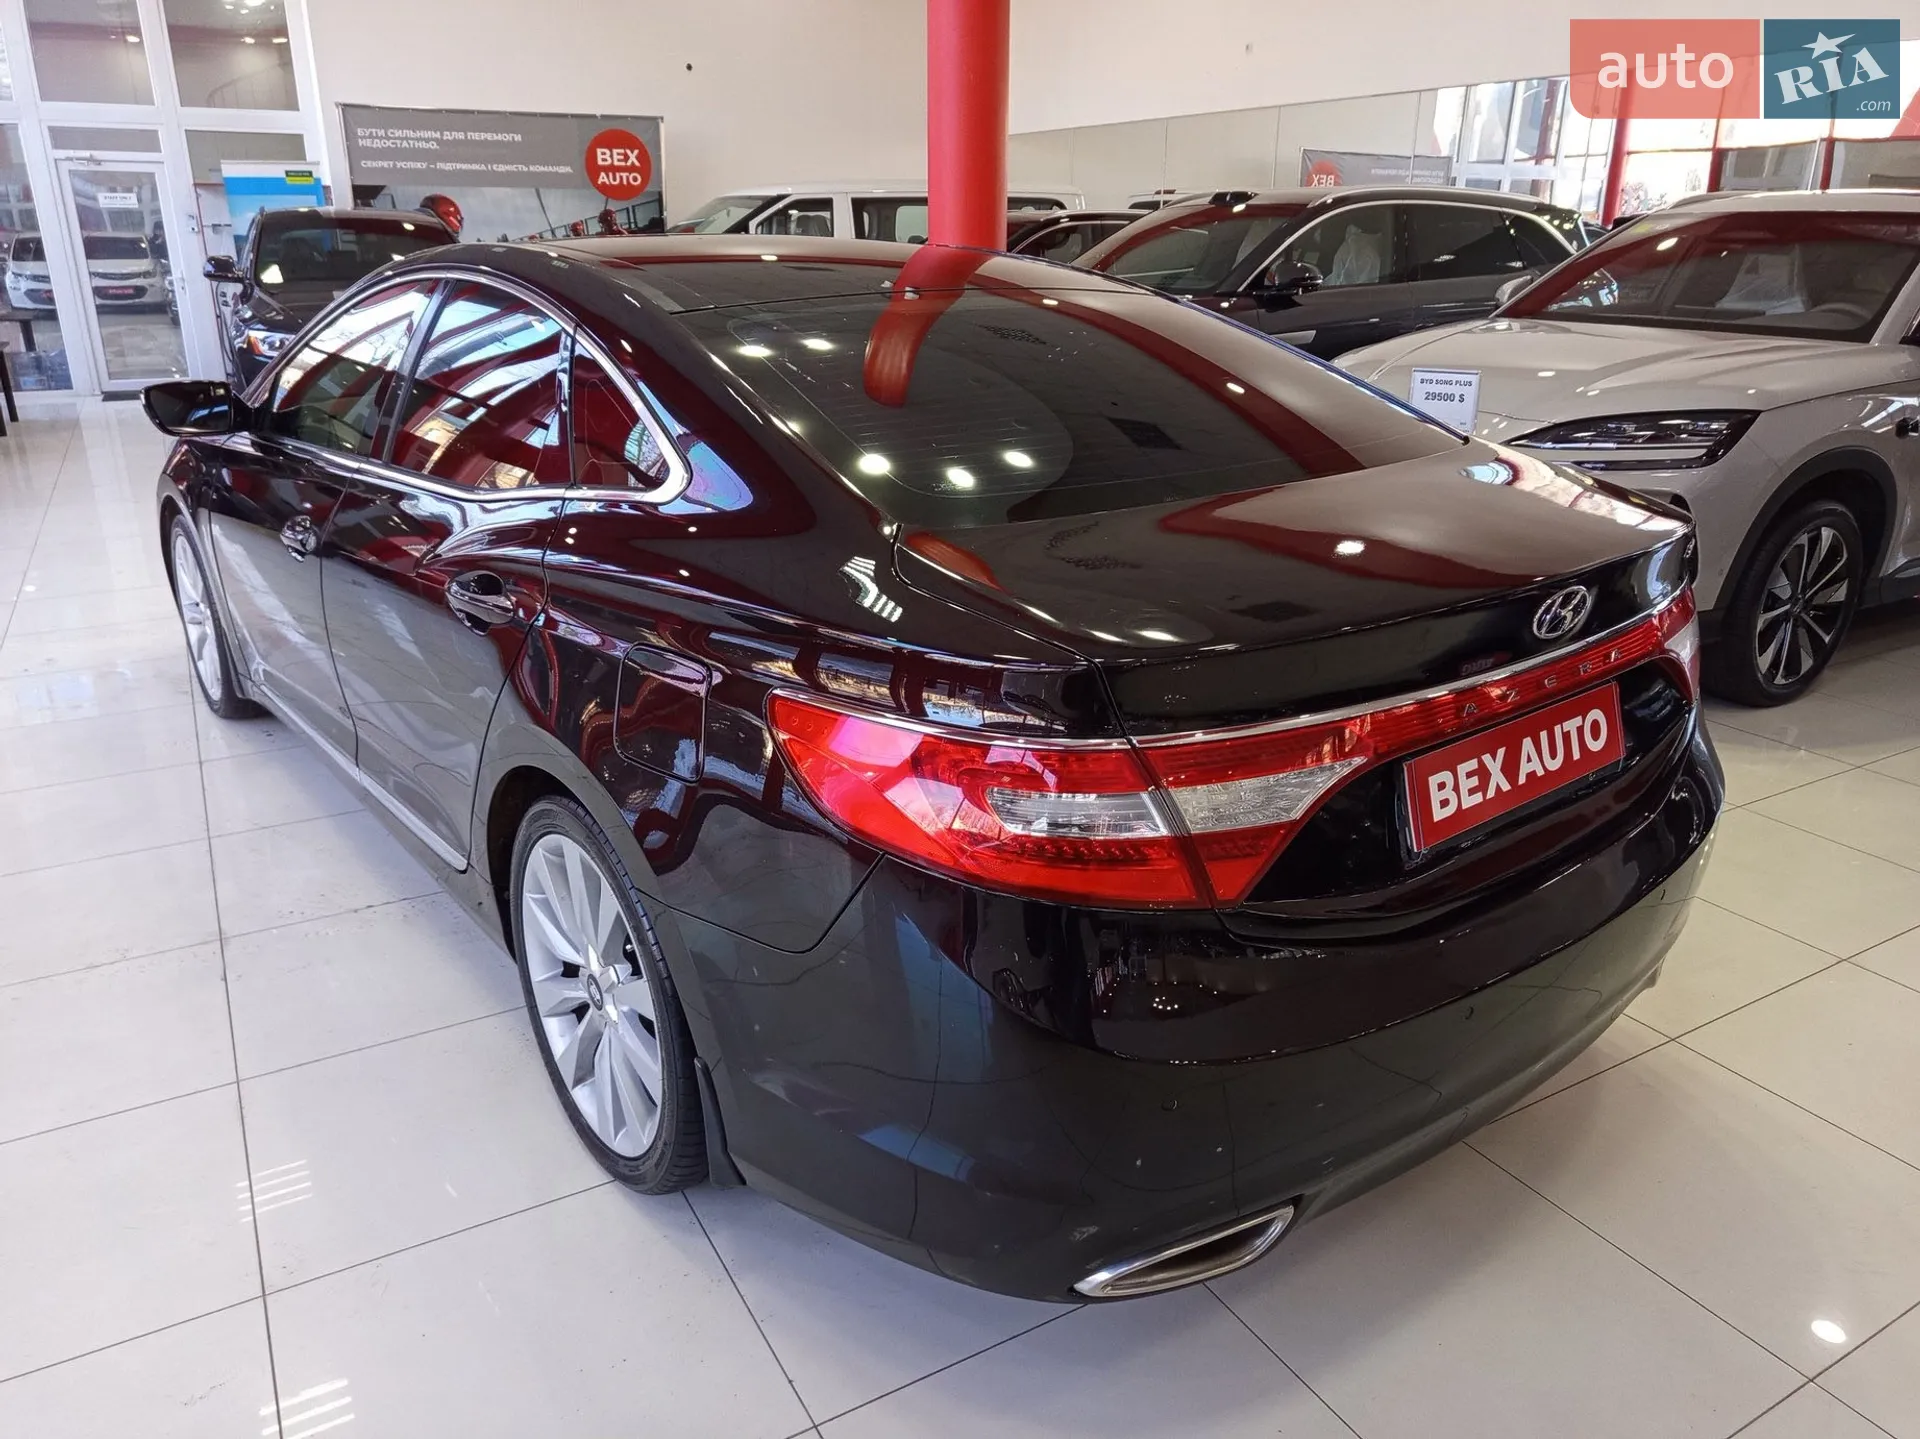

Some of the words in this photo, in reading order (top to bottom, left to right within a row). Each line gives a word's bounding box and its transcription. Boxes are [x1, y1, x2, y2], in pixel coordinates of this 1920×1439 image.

[357, 128, 385, 137] БУТИ
[387, 128, 441, 139] СИЛЬНИМ
[443, 131, 465, 140] ДЛЯ
[467, 132, 523, 142] ПЕРЕМОГИ
[358, 138, 440, 149] НЕДОСТАТНЬО.
[361, 160, 393, 169] СЕКРЕТ
[596, 148, 641, 167] BEX
[597, 172, 642, 187] AUTO
[1424, 391, 1456, 402] 29500
[1458, 393, 1465, 404] $
[1428, 747, 1512, 822] BEX
[1518, 708, 1608, 785] AUTO
